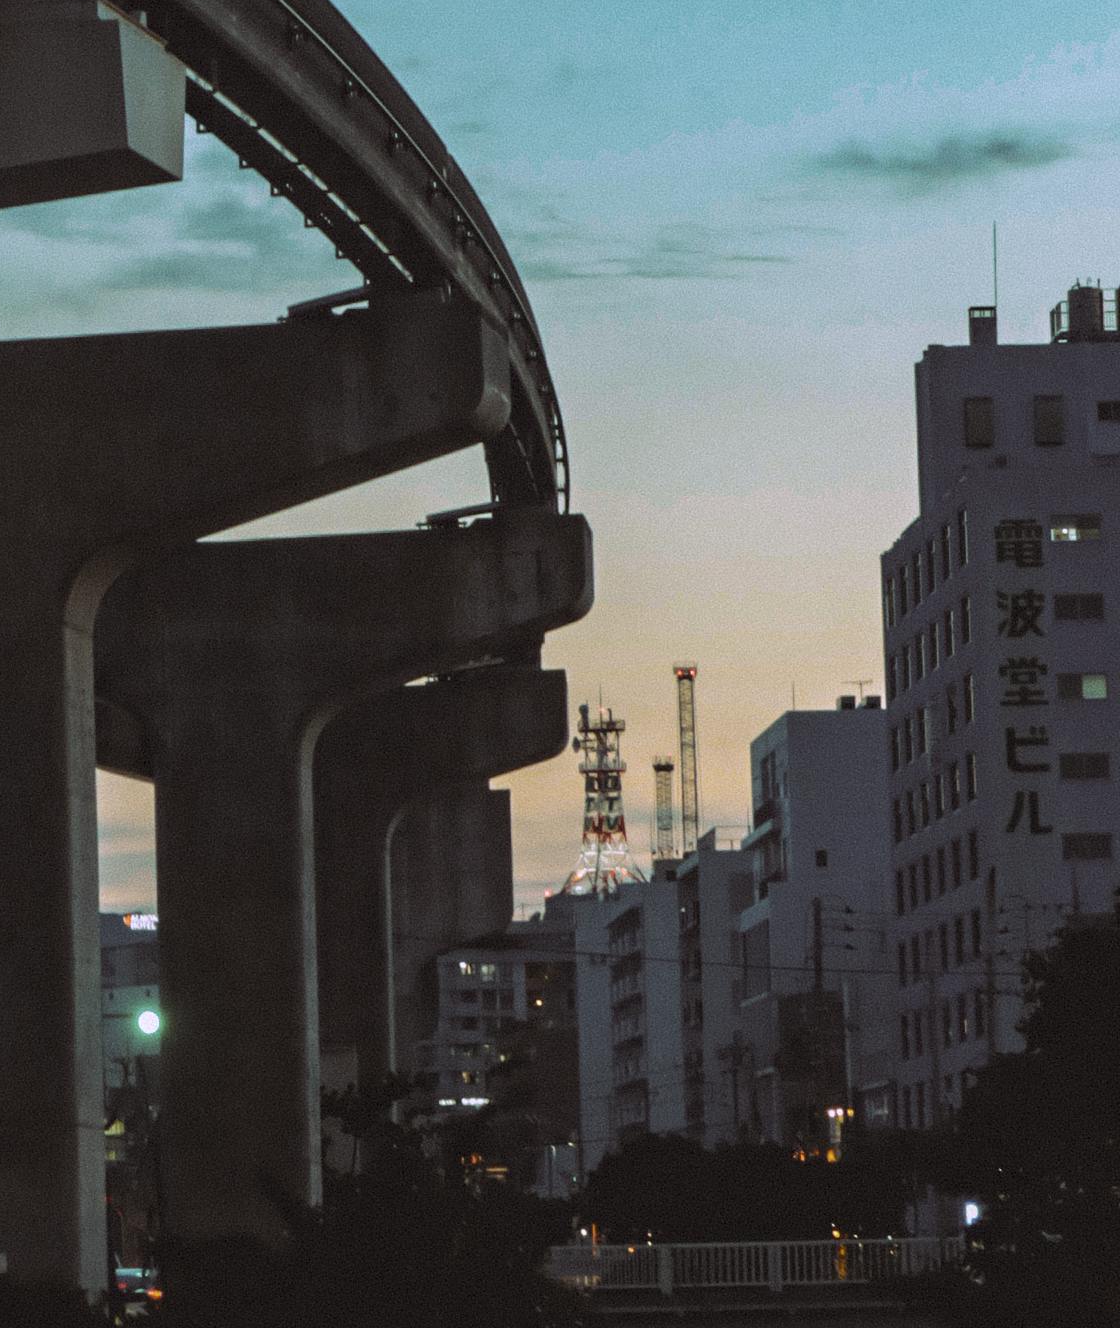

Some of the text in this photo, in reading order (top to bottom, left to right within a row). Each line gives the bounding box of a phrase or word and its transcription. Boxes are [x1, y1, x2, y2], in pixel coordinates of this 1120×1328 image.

[993, 518, 1054, 835] 電波堂ビル
